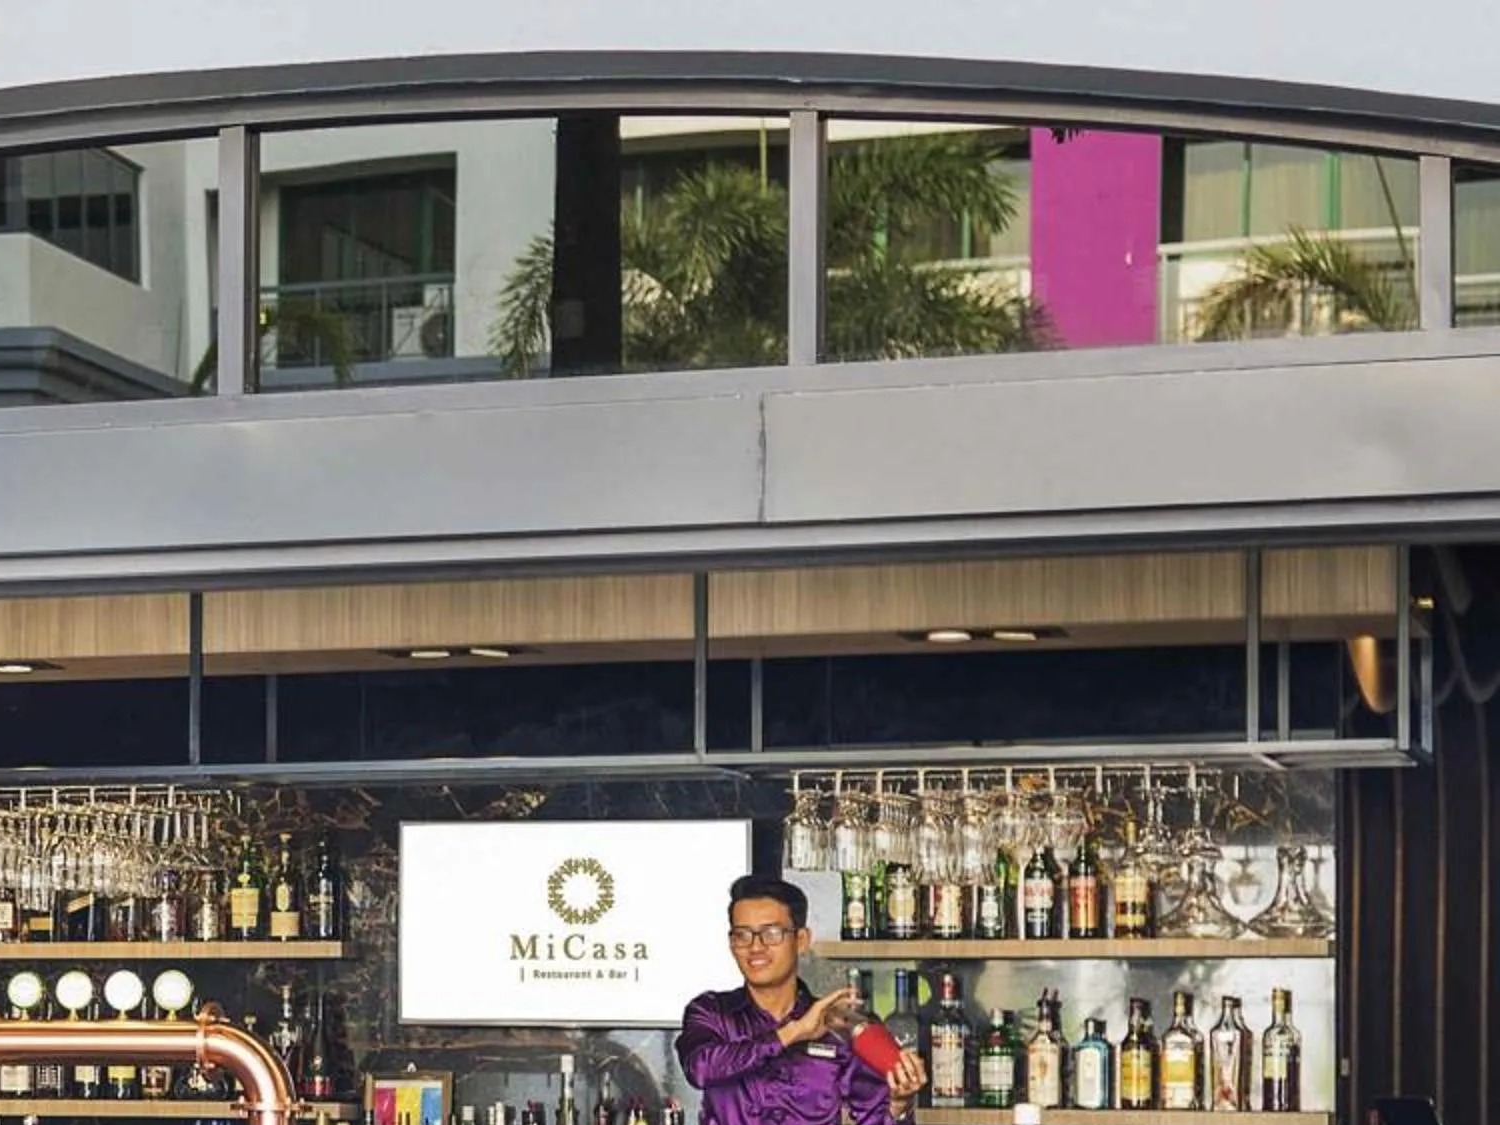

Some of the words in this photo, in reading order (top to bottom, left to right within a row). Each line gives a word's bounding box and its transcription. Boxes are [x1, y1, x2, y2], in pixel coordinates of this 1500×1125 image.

[509, 933, 649, 960] MiCasa
[532, 969, 592, 979] Restaurant
[608, 969, 628, 979] Bar
